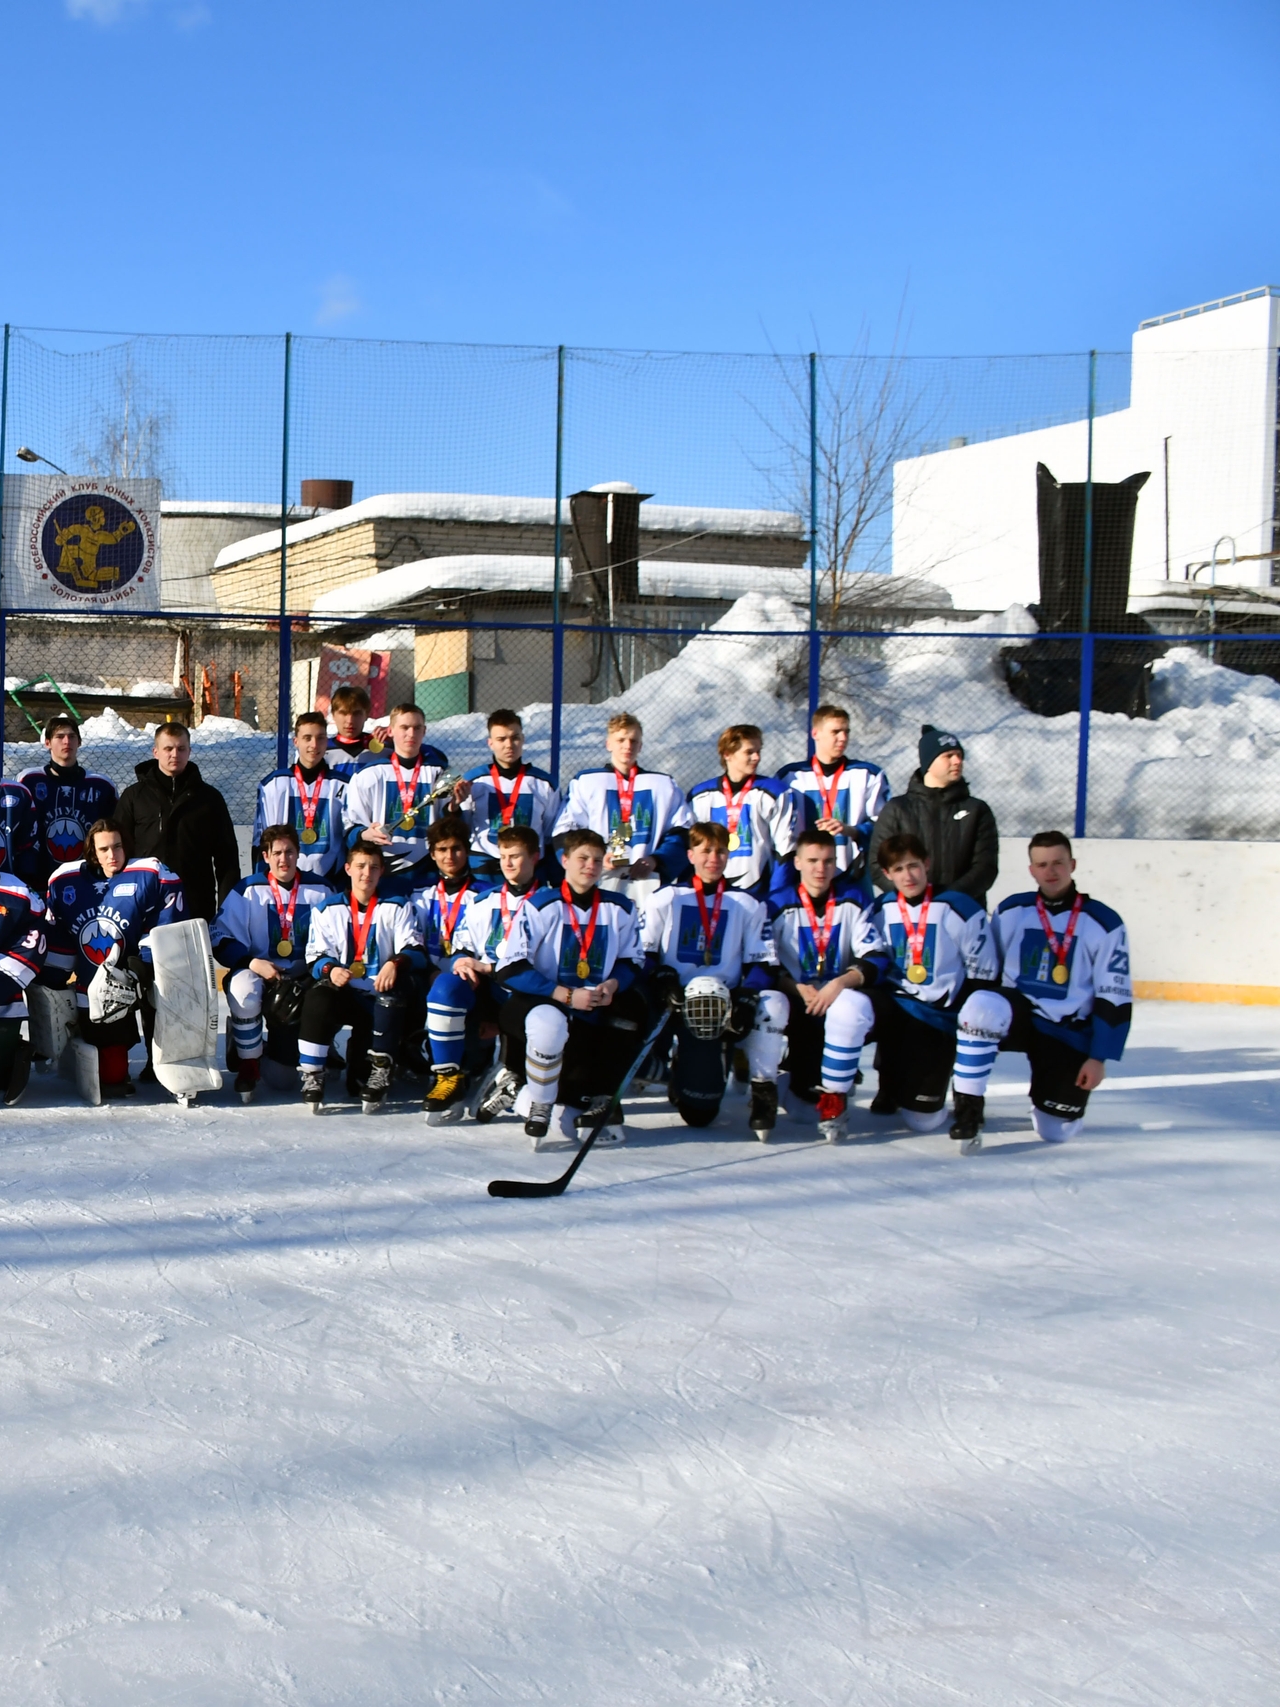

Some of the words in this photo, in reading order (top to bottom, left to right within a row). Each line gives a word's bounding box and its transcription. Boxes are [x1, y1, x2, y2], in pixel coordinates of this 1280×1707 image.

[71, 482, 99, 492] КЛУБ
[104, 484, 135, 506] ЮНЫХ
[50, 583, 98, 603] ЗОЛОТАЯ
[99, 586, 136, 604] ШАЙБА
[70, 904, 130, 935] ИМПУЛЬС
[1042, 1099, 1081, 1113] CCM
